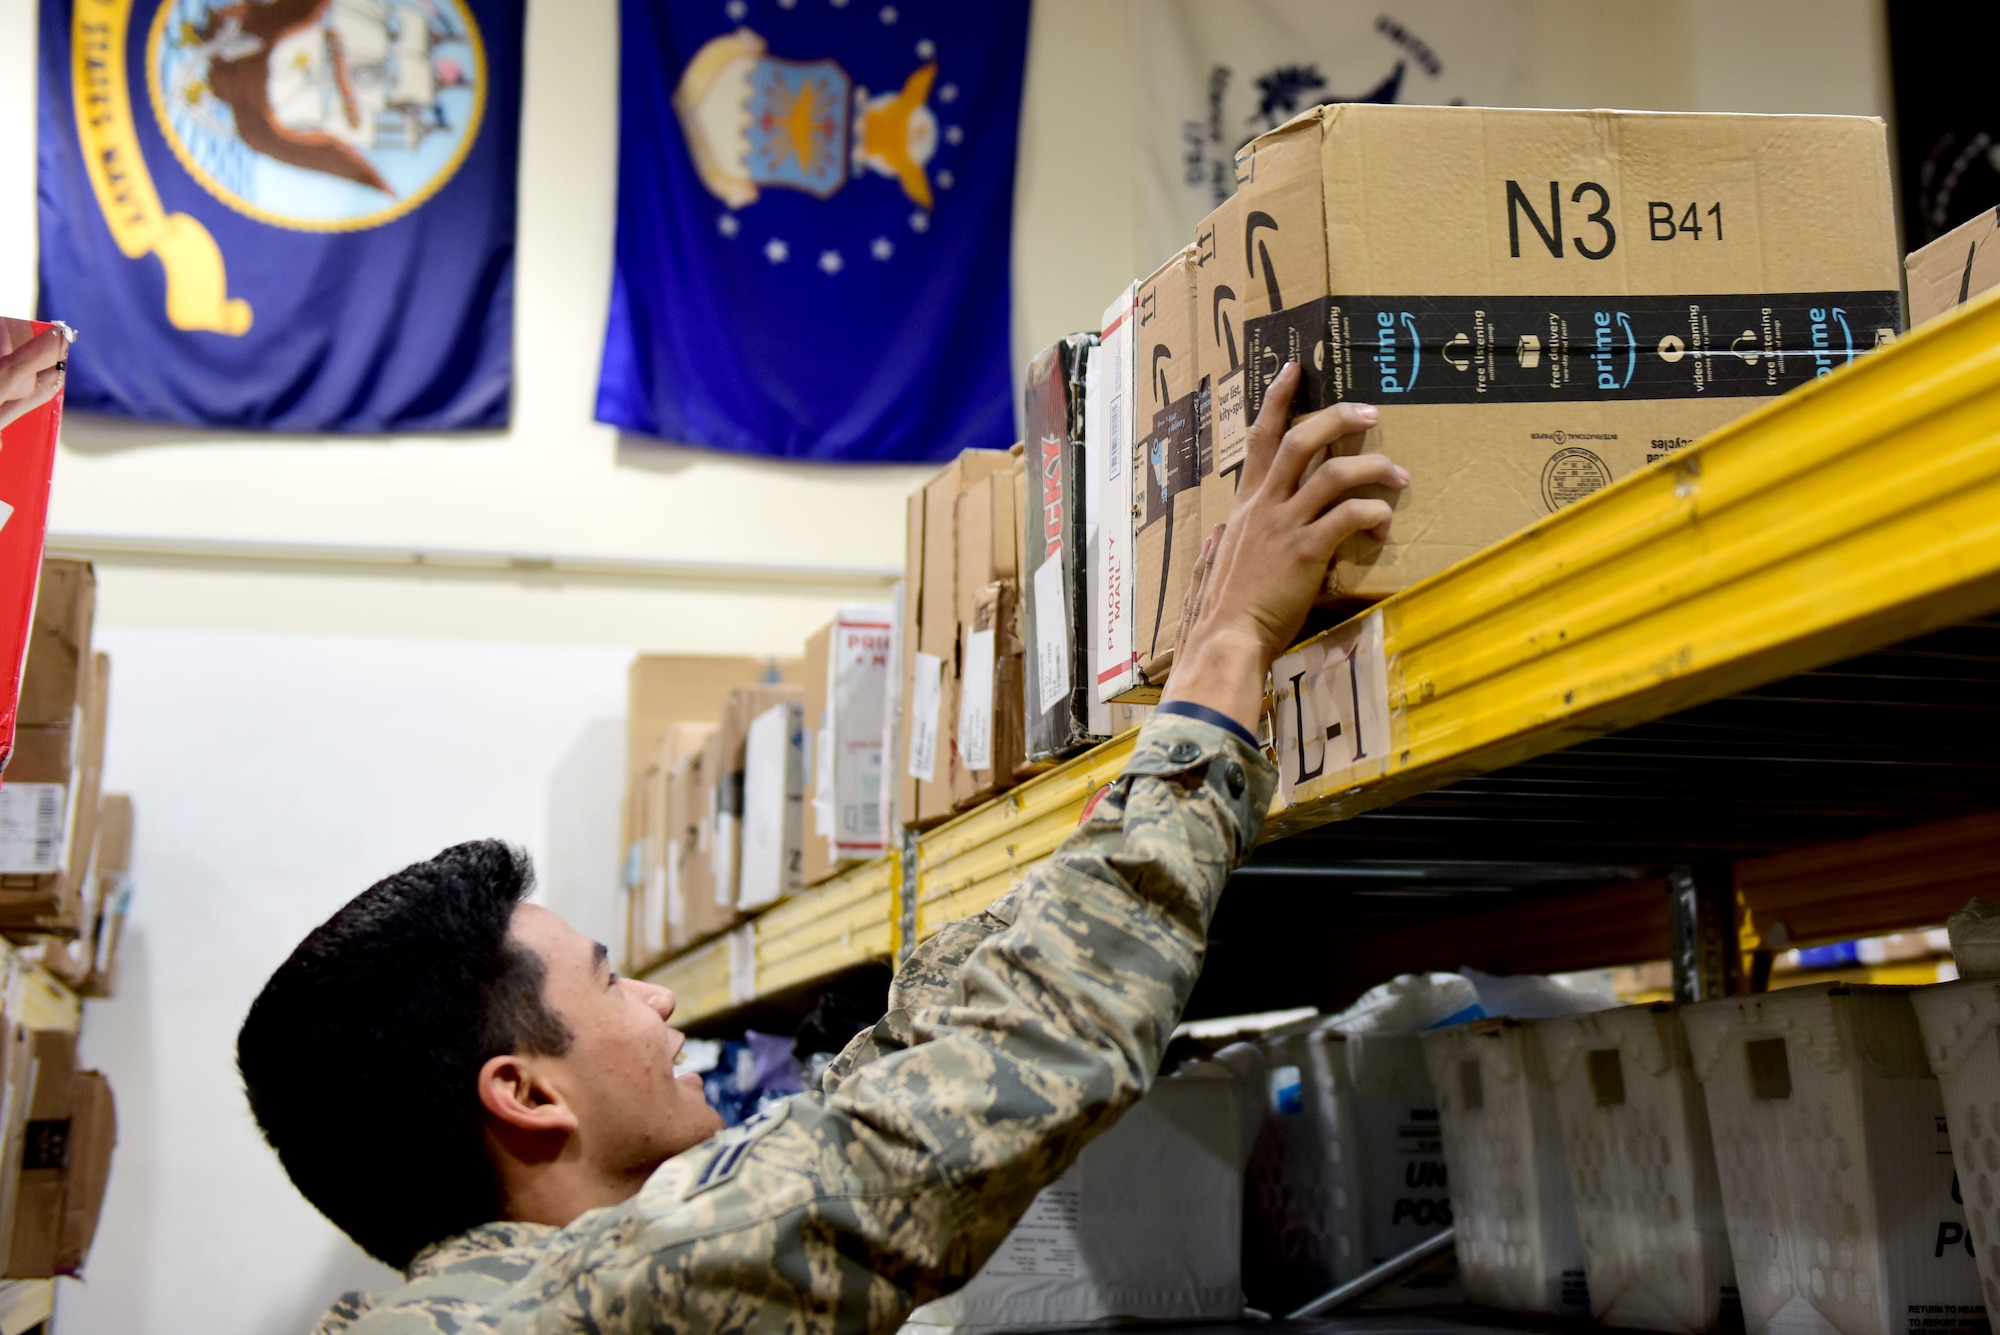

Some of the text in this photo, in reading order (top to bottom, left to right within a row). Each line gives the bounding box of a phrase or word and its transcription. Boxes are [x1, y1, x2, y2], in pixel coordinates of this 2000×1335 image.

[100, 146, 145, 227] NAVY
[1505, 180, 1723, 260] N3 B41
[1486, 323, 1495, 343] songs
[1560, 319, 1568, 340] faster
[1701, 314, 1709, 336] shows
[1344, 348, 1352, 363] and
[1373, 312, 1404, 393] prime
[1473, 310, 1487, 393] free listening
[1548, 312, 1561, 389] free delivery
[1590, 312, 1621, 389] prime
[1688, 304, 1705, 392] video sreaming
[1344, 362, 1353, 389] movies
[1561, 354, 1570, 383] two-day
[1765, 361, 1778, 386] free
[1253, 355, 1261, 411] listening
[1332, 367, 1344, 399] video
[1530, 432, 1618, 441] INTERNATIONAL PAPER
[1651, 437, 1697, 452] ecycles
[1107, 536, 1115, 651] PRIORITY
[1392, 1198, 1454, 1226] POS
[1908, 1305, 1988, 1314] RETURN TO NEARE
[1909, 1318, 1921, 1327] TO
[1922, 1318, 1957, 1327] REPORT
